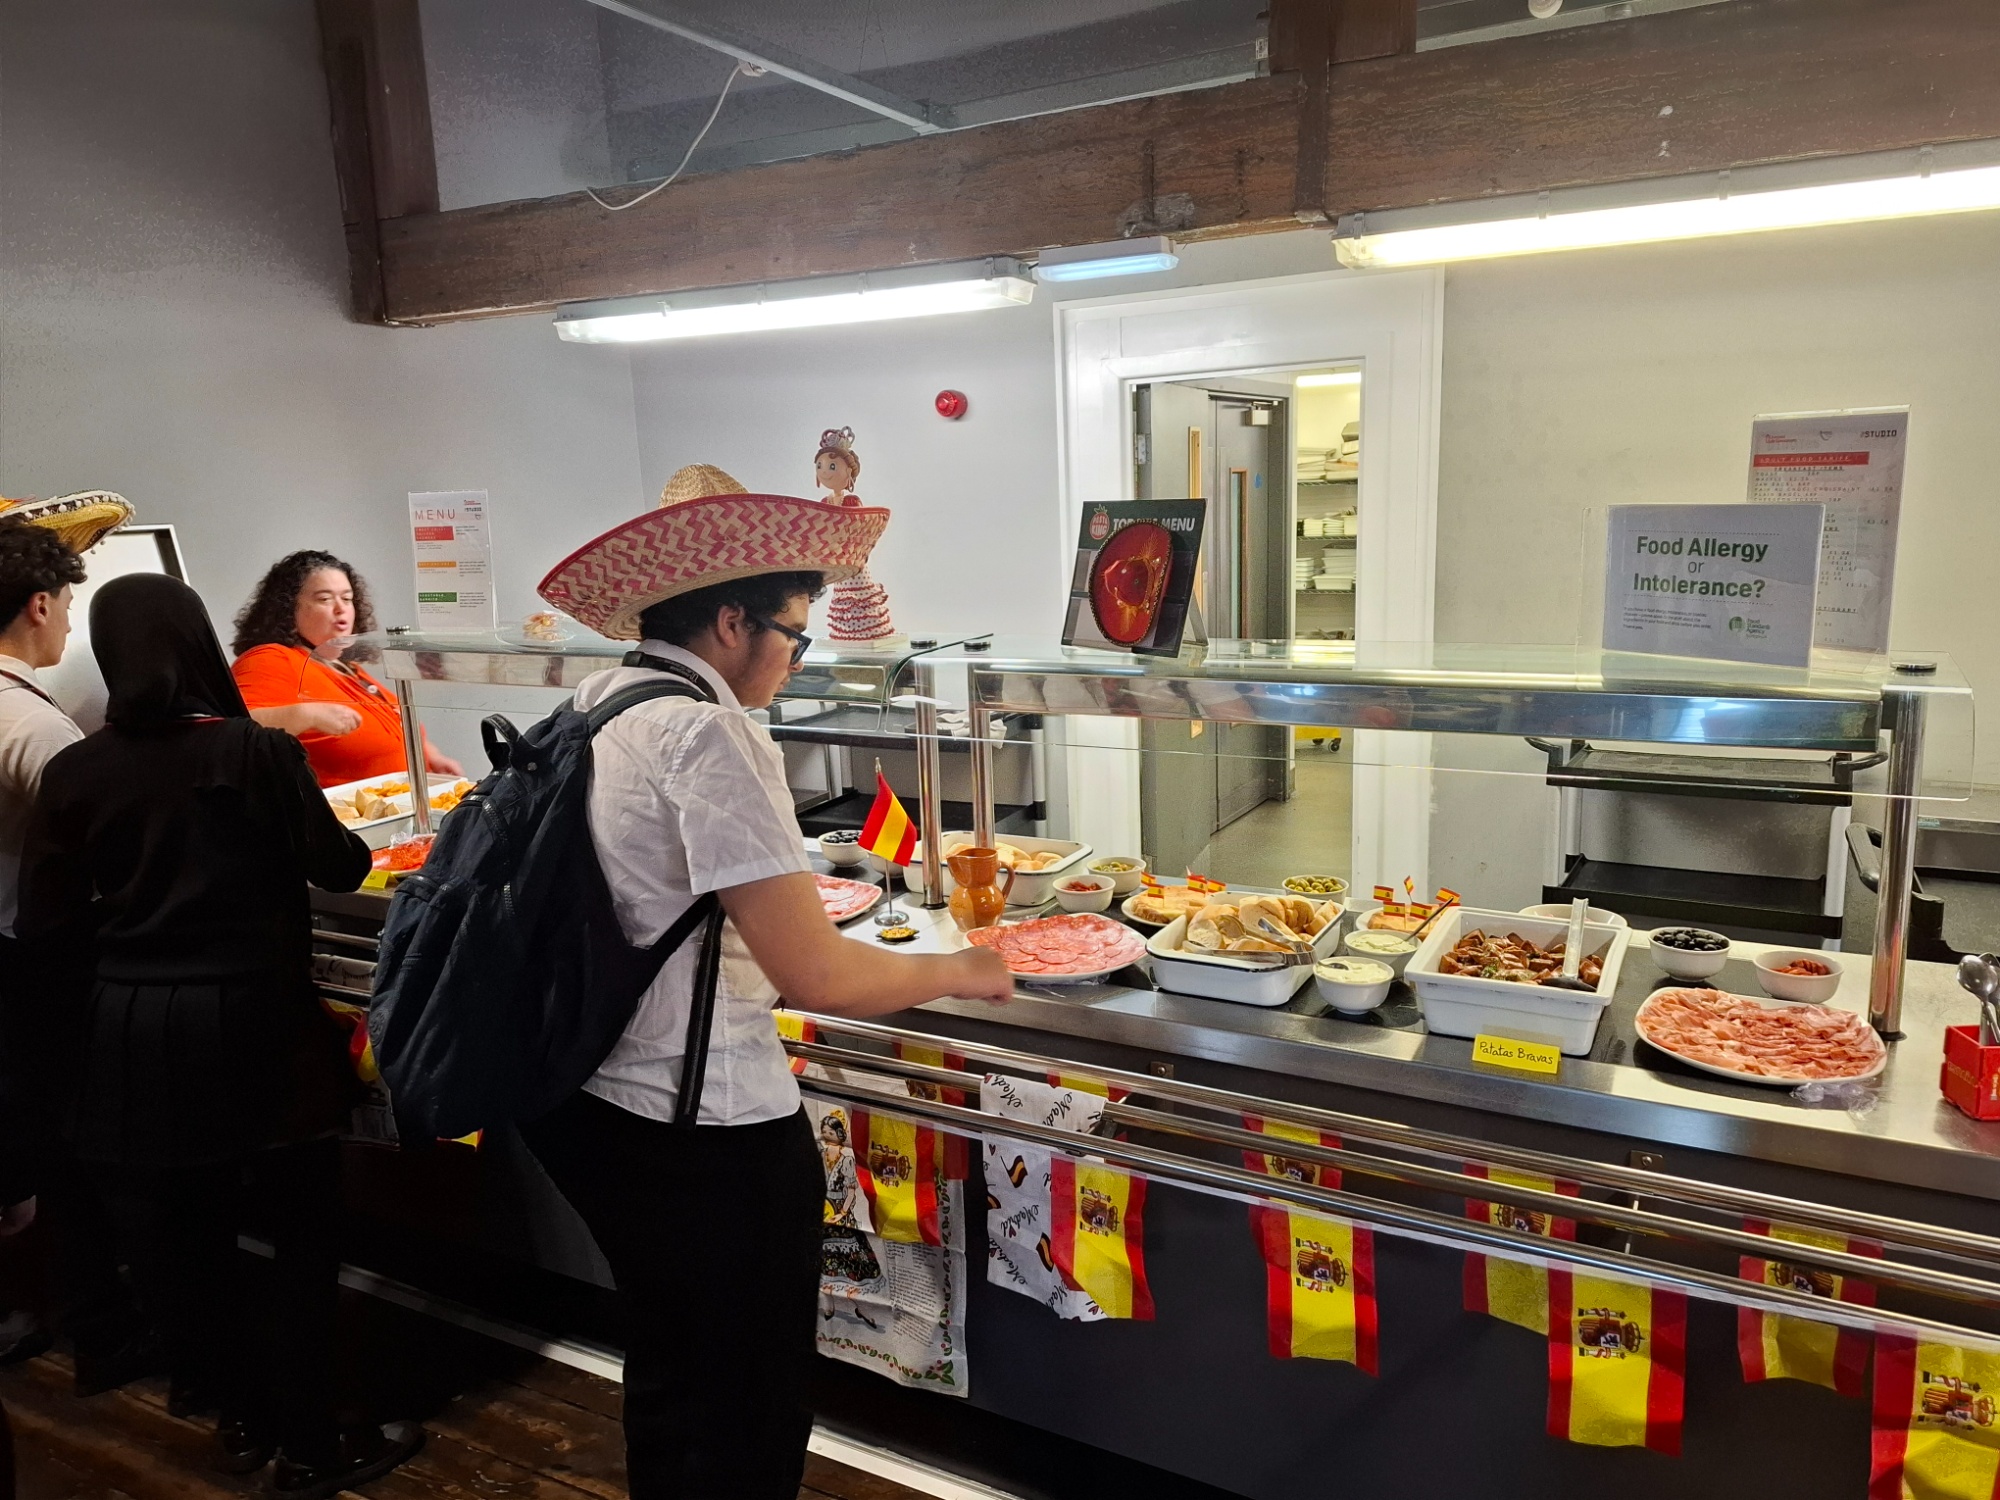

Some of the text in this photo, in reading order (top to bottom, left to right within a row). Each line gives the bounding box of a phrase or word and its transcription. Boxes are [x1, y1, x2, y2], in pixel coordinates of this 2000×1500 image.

[415, 508, 456, 521] MENU
[1636, 536, 1769, 563] Food Allergy
[1687, 561, 1705, 574] or
[1633, 572, 1767, 599] Intolerance?
[1480, 1041, 1554, 1065] Patatas Bravas
[1000, 1204, 1039, 1238] Madrid
